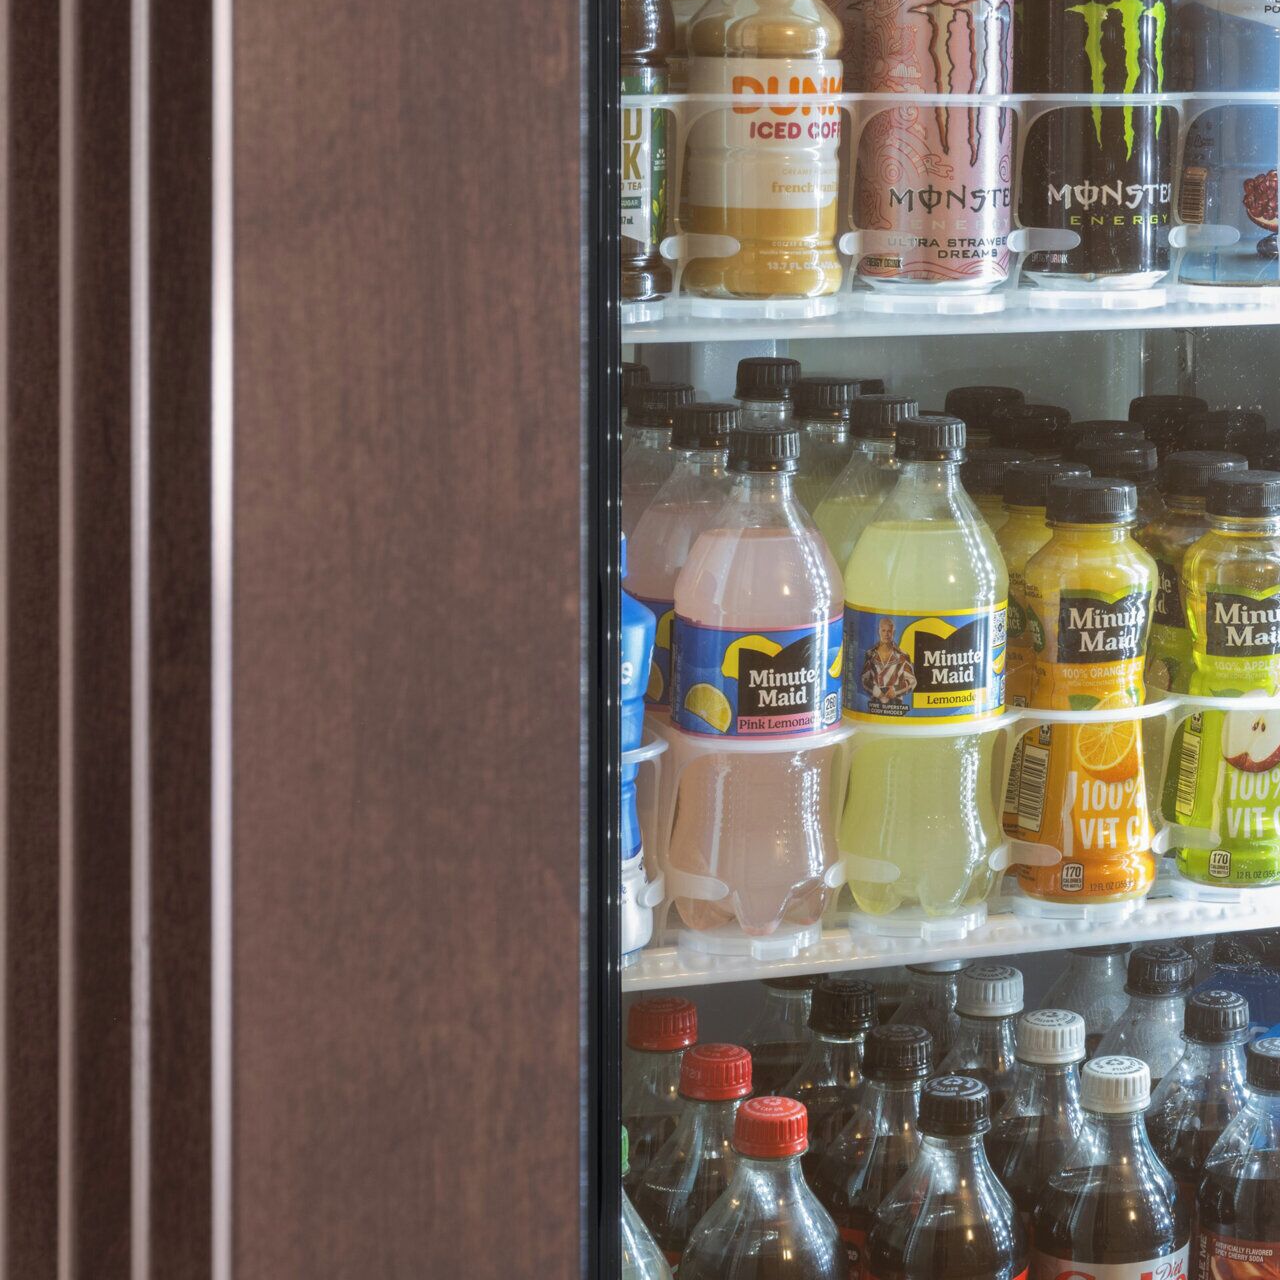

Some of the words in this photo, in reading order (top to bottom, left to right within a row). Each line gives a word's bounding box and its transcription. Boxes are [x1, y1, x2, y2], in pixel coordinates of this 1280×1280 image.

[749, 121, 802, 140] ICED
[1070, 214, 1169, 225] ENERGY
[938, 248, 998, 260] DREAMS
[1067, 606, 1146, 629] Minute
[1078, 626, 1137, 652] Maid
[923, 649, 982, 667] Minute
[1215, 661, 1241, 671] 100%
[1244, 660, 1276, 670] APPLE
[748, 667, 817, 688] Minute
[930, 665, 975, 685] Maid
[1062, 668, 1089, 679] 100%
[757, 686, 808, 708] Maid
[881, 708, 904, 716] RHODES
[740, 718, 765, 730] Pink
[1081, 778, 1141, 812] 100%
[1227, 806, 1266, 839] VIT
[1080, 817, 1119, 850] VIT
[1212, 851, 1229, 866] 170
[1064, 865, 1082, 878] 170
[1215, 1240, 1245, 1254] ARTIFICIALLY
[1245, 1248, 1273, 1257] FLAVORED
[1215, 1247, 1228, 1258] SPICY
[1228, 1250, 1248, 1261] CHERRY
[1155, 1257, 1184, 1280] Diet
